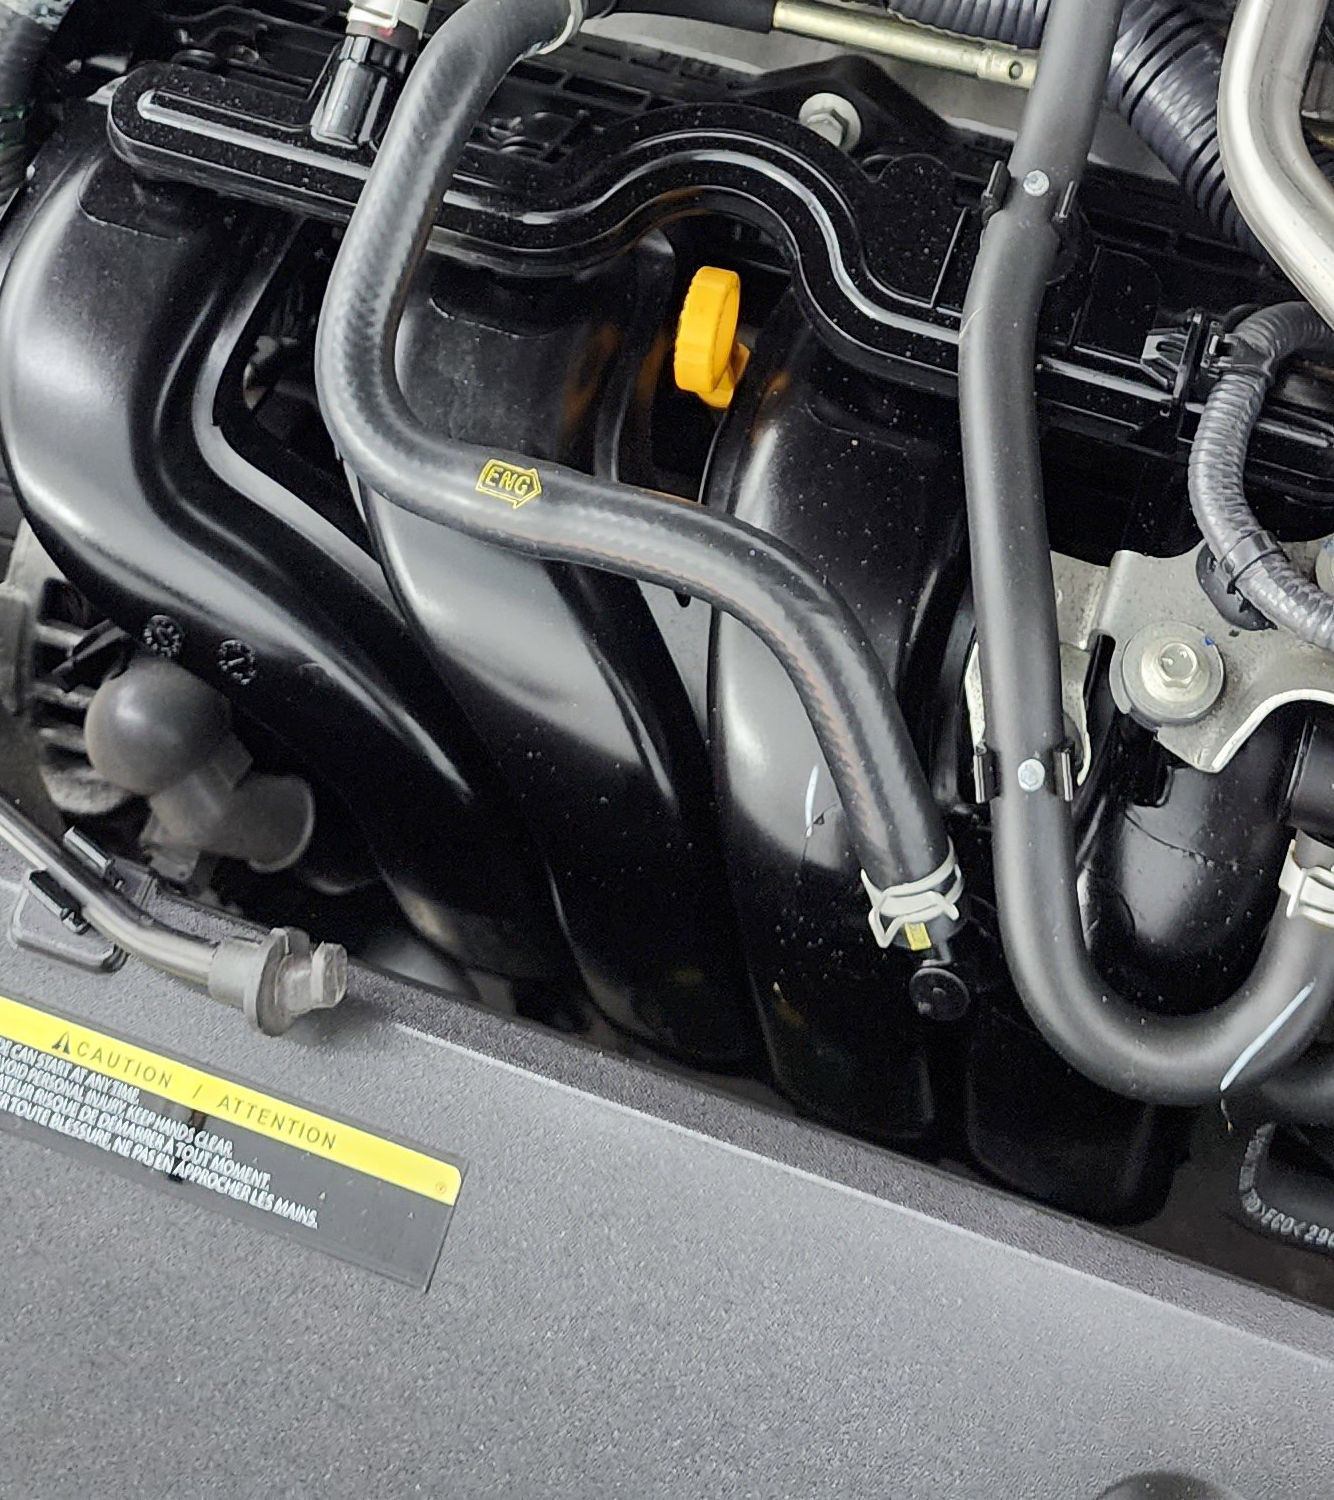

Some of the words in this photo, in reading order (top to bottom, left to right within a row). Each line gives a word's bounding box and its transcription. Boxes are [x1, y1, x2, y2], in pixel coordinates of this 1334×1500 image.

[484, 466, 531, 496] ENG
[9, 1042, 36, 1065] CAN
[35, 1052, 70, 1078] START
[70, 1065, 86, 1084] AT
[84, 1071, 110, 1093] ANY
[26, 1066, 85, 1101] PERSONAL
[125, 1104, 154, 1128] KEEP
[153, 1113, 195, 1143] HANDS
[76, 1039, 171, 1088] CAUTION
[217, 1091, 336, 1150] ATTENTION
[7, 1095, 49, 1124] TOUTE
[111, 1135, 132, 1156] NE
[130, 1142, 155, 1165] PAS
[153, 1151, 173, 1172] EN
[171, 1158, 250, 1201] APPROCHER
[248, 1187, 274, 1210] LES
[32, 1086, 78, 1117] RISQUE
[78, 1104, 97, 1124] DE
[173, 1140, 211, 1167] TOUT
